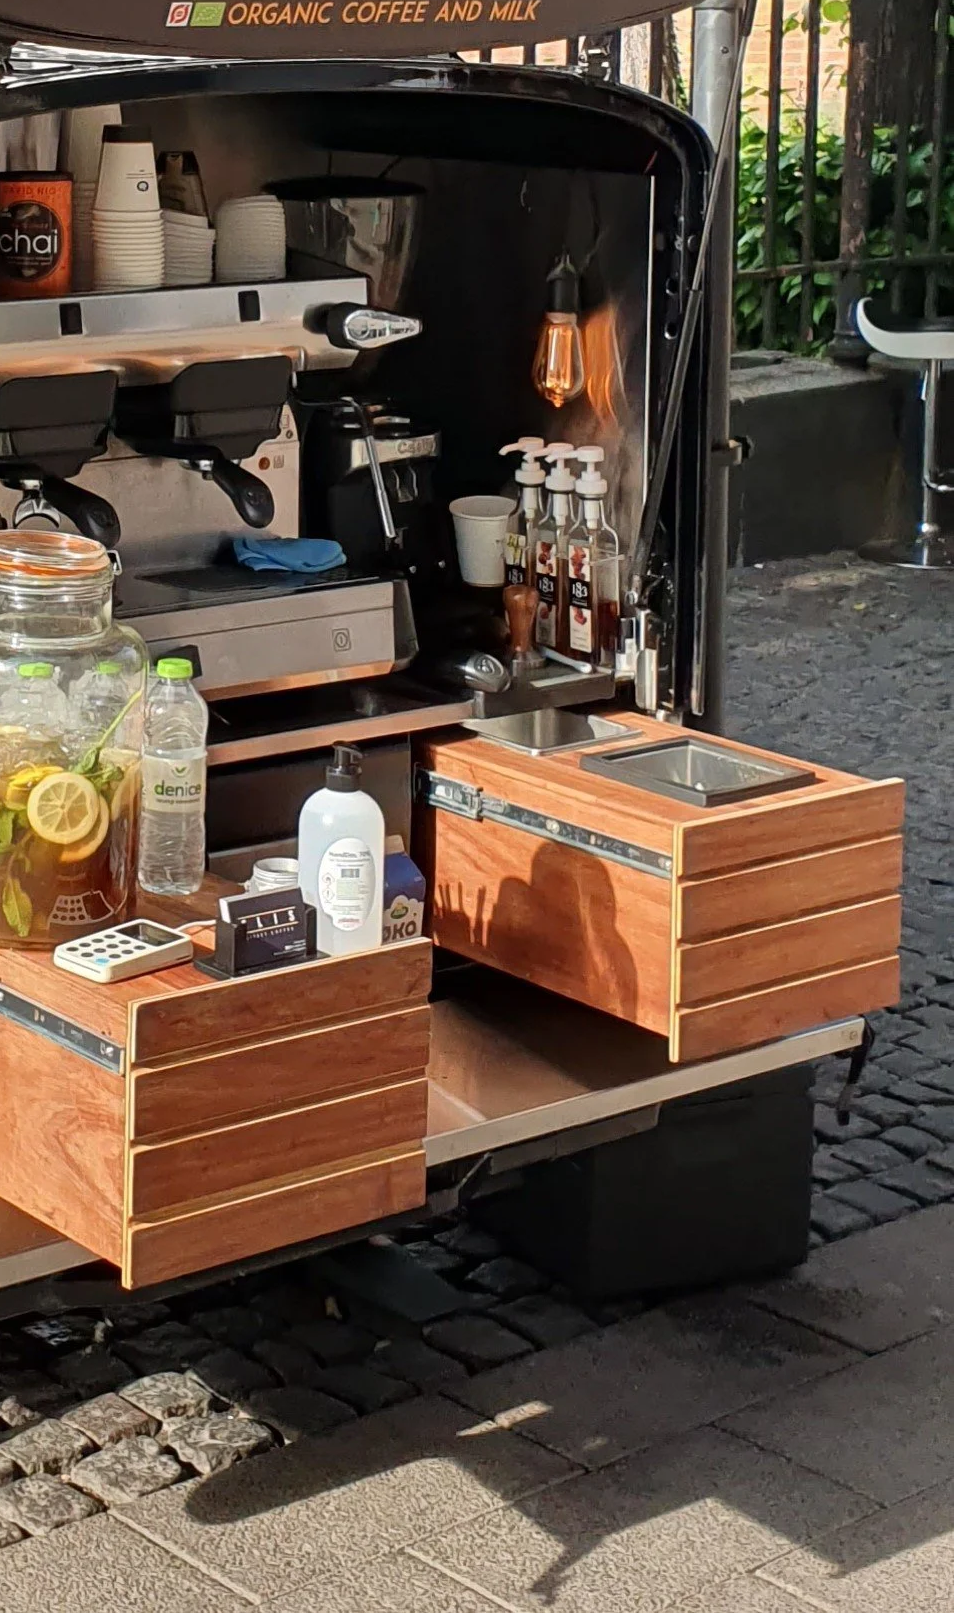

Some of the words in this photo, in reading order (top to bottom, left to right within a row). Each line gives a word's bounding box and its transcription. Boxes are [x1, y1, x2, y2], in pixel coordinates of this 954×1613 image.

[227, 2, 334, 25] ORGANIC
[341, 0, 429, 23] COFFEE
[434, 0, 482, 22] AND
[489, 0, 541, 22] MILK
[0, 228, 58, 254] chai
[241, 909, 296, 929] LIS
